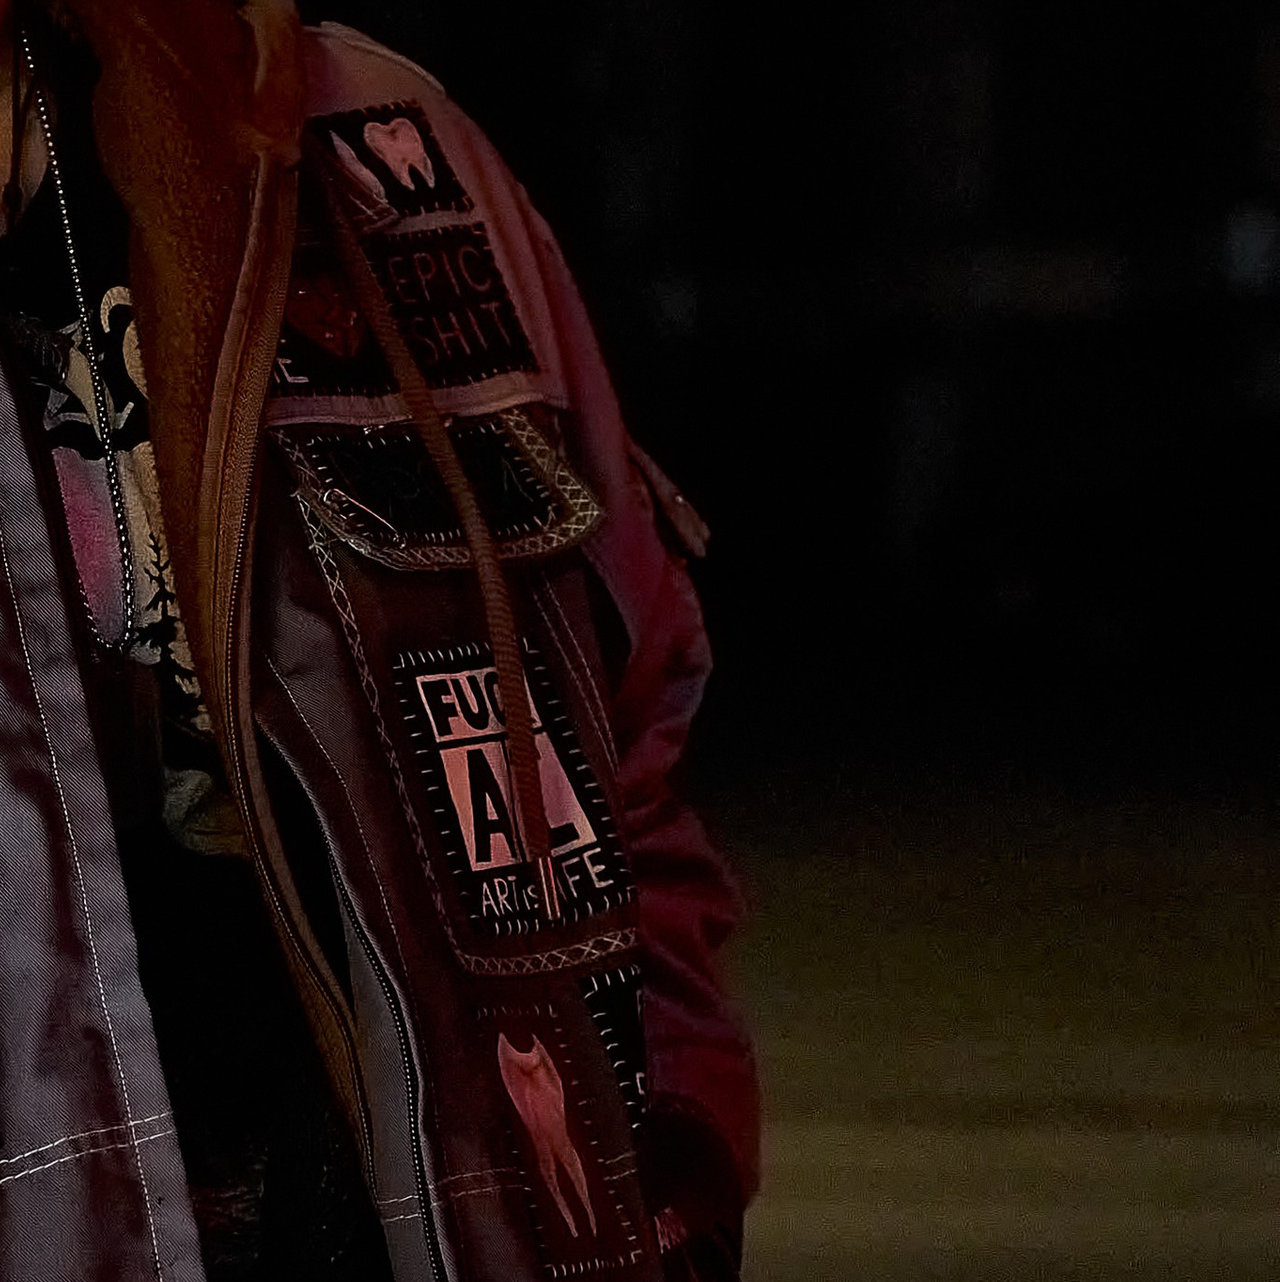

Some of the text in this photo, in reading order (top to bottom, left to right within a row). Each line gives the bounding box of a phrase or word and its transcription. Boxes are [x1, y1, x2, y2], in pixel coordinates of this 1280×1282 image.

[387, 244, 492, 304] EPIC
[411, 301, 512, 364] SHIT
[420, 669, 508, 737] FUC
[482, 875, 520, 917] ART
